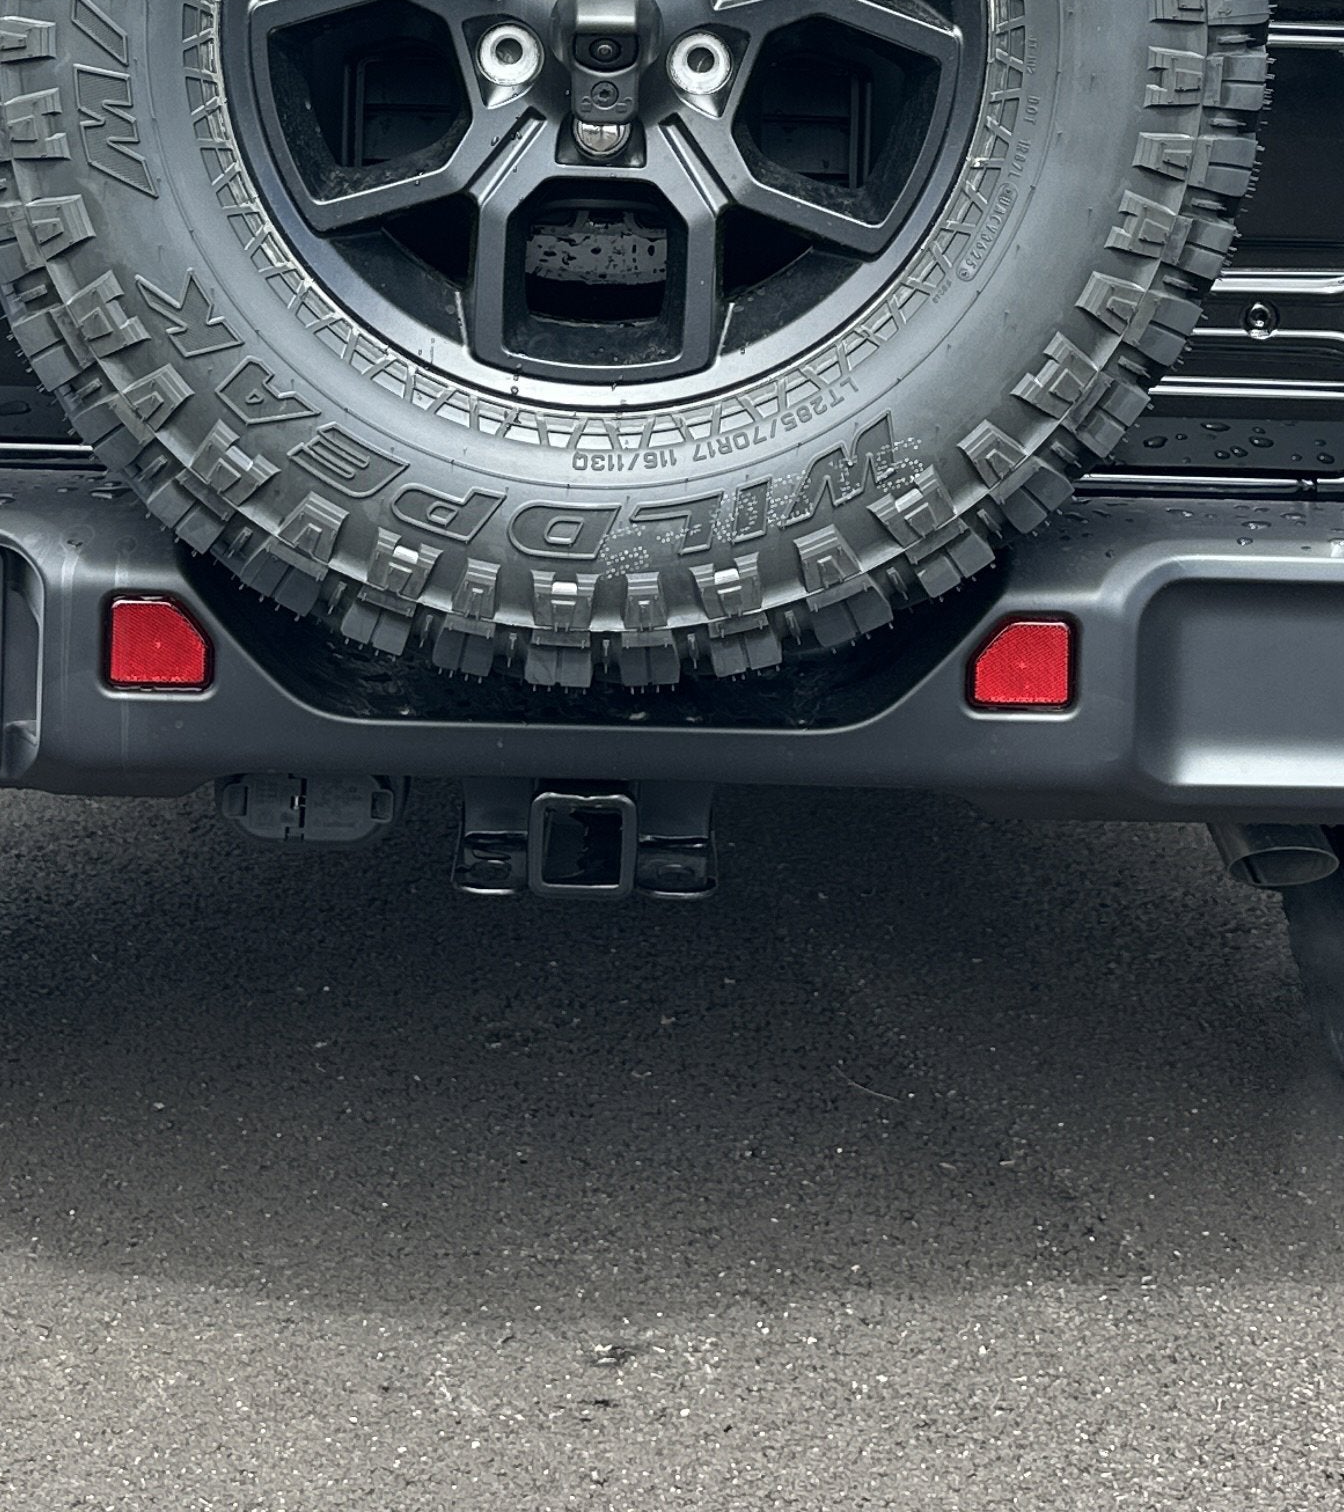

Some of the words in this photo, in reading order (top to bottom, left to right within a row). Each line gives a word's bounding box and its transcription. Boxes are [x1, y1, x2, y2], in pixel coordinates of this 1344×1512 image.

[1022, 93, 1041, 126] DOT
[135, 267, 894, 559] WILDPEAK
[693, 376, 860, 462] LT285/70R17
[571, 450, 677, 472] 116/113Q
